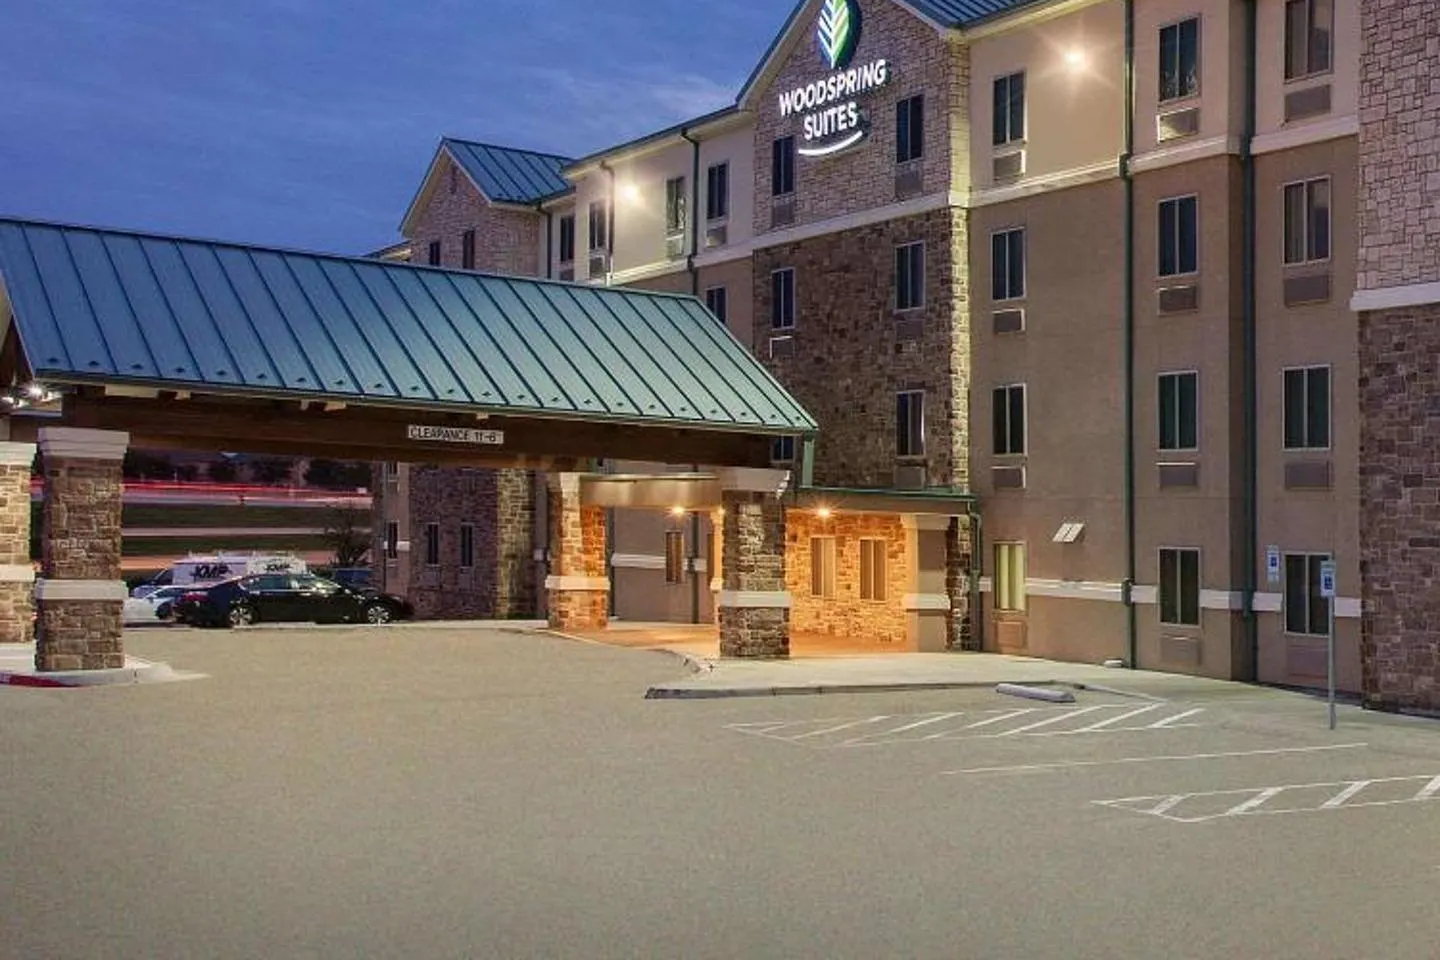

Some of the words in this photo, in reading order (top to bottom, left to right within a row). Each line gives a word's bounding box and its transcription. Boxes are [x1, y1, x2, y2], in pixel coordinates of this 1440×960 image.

[779, 59, 886, 116] WOODSPRING
[804, 101, 858, 141] SUITES
[410, 426, 468, 441] CLEARANCE
